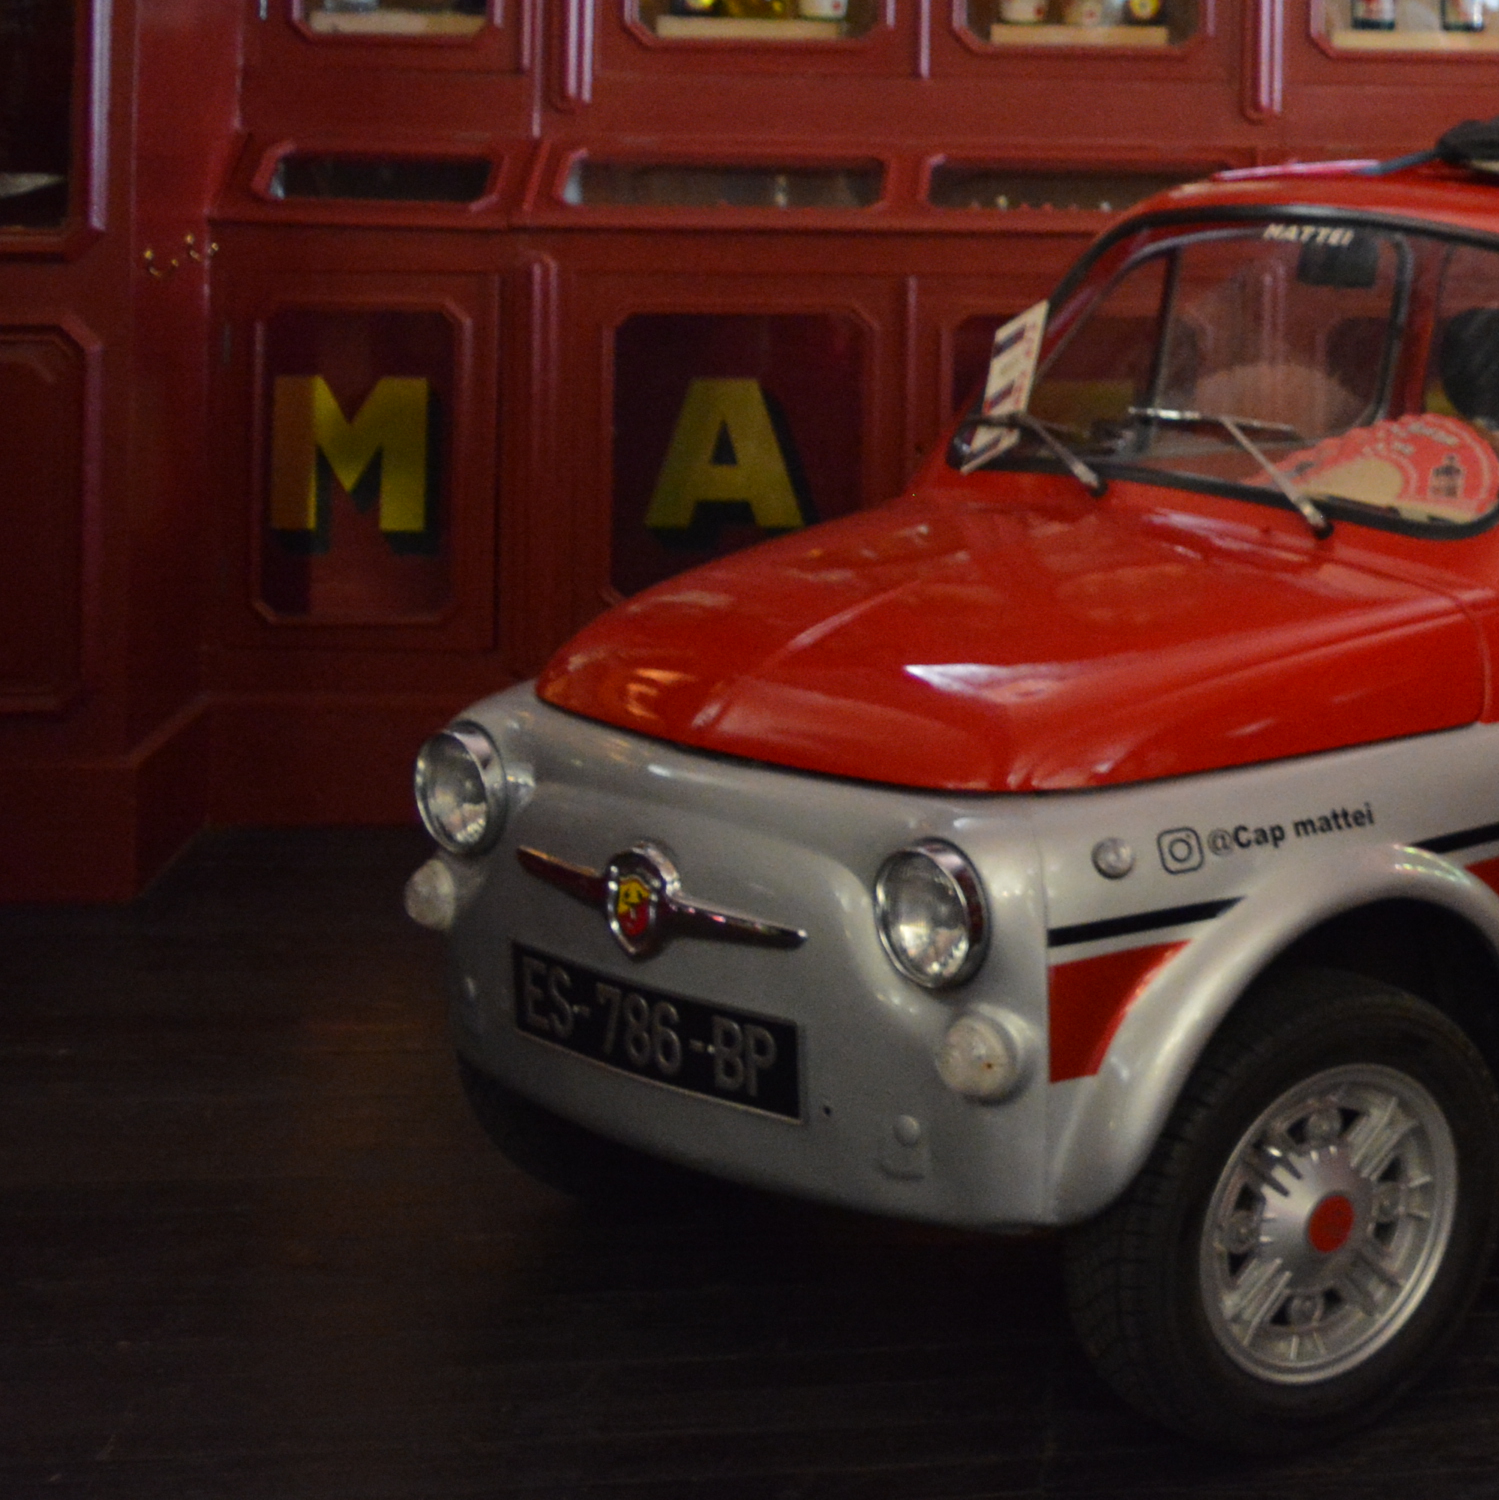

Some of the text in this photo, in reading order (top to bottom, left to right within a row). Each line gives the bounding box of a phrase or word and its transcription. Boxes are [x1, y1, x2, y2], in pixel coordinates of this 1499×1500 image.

[1263, 222, 1354, 247] MATTEI
[271, 375, 805, 532] M A
[1206, 801, 1375, 858] @Cap mattei
[521, 955, 778, 1098] ES-786-BP
